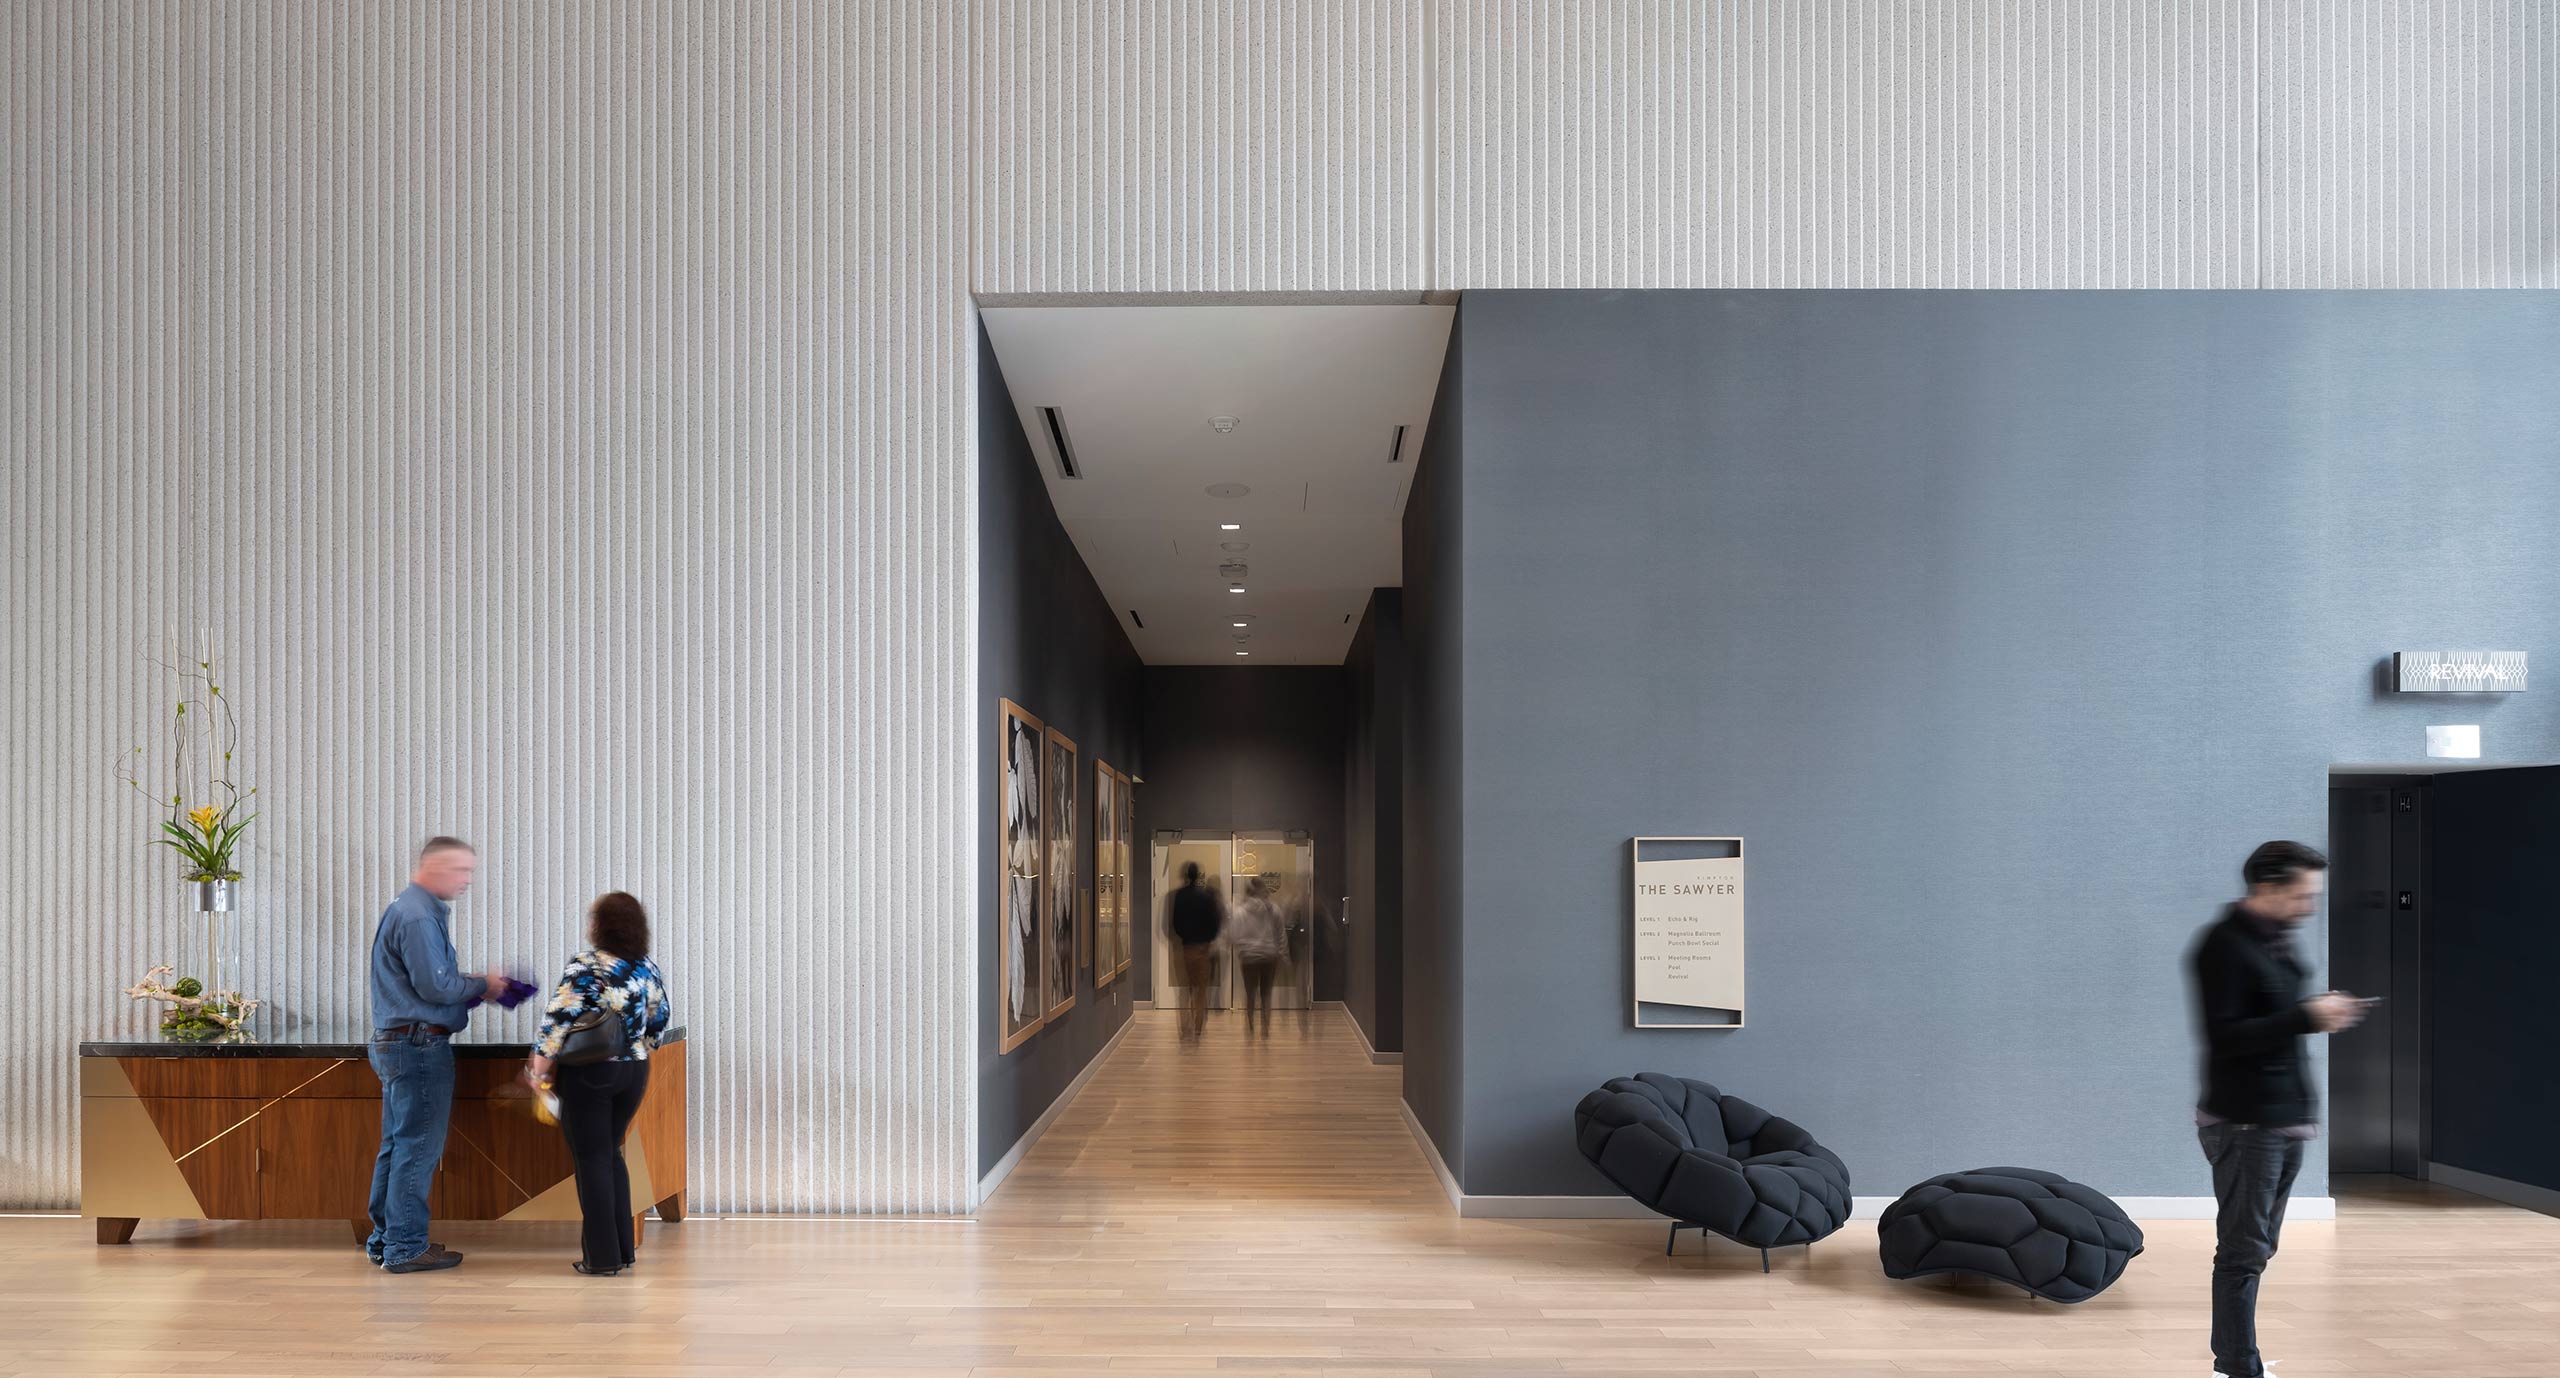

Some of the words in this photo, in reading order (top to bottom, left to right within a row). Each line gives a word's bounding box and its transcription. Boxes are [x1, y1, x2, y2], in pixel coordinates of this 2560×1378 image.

[2430, 663, 2509, 680] REVIVAL
[1639, 884, 1666, 895] THE
[1673, 884, 1735, 895] SAWYER
